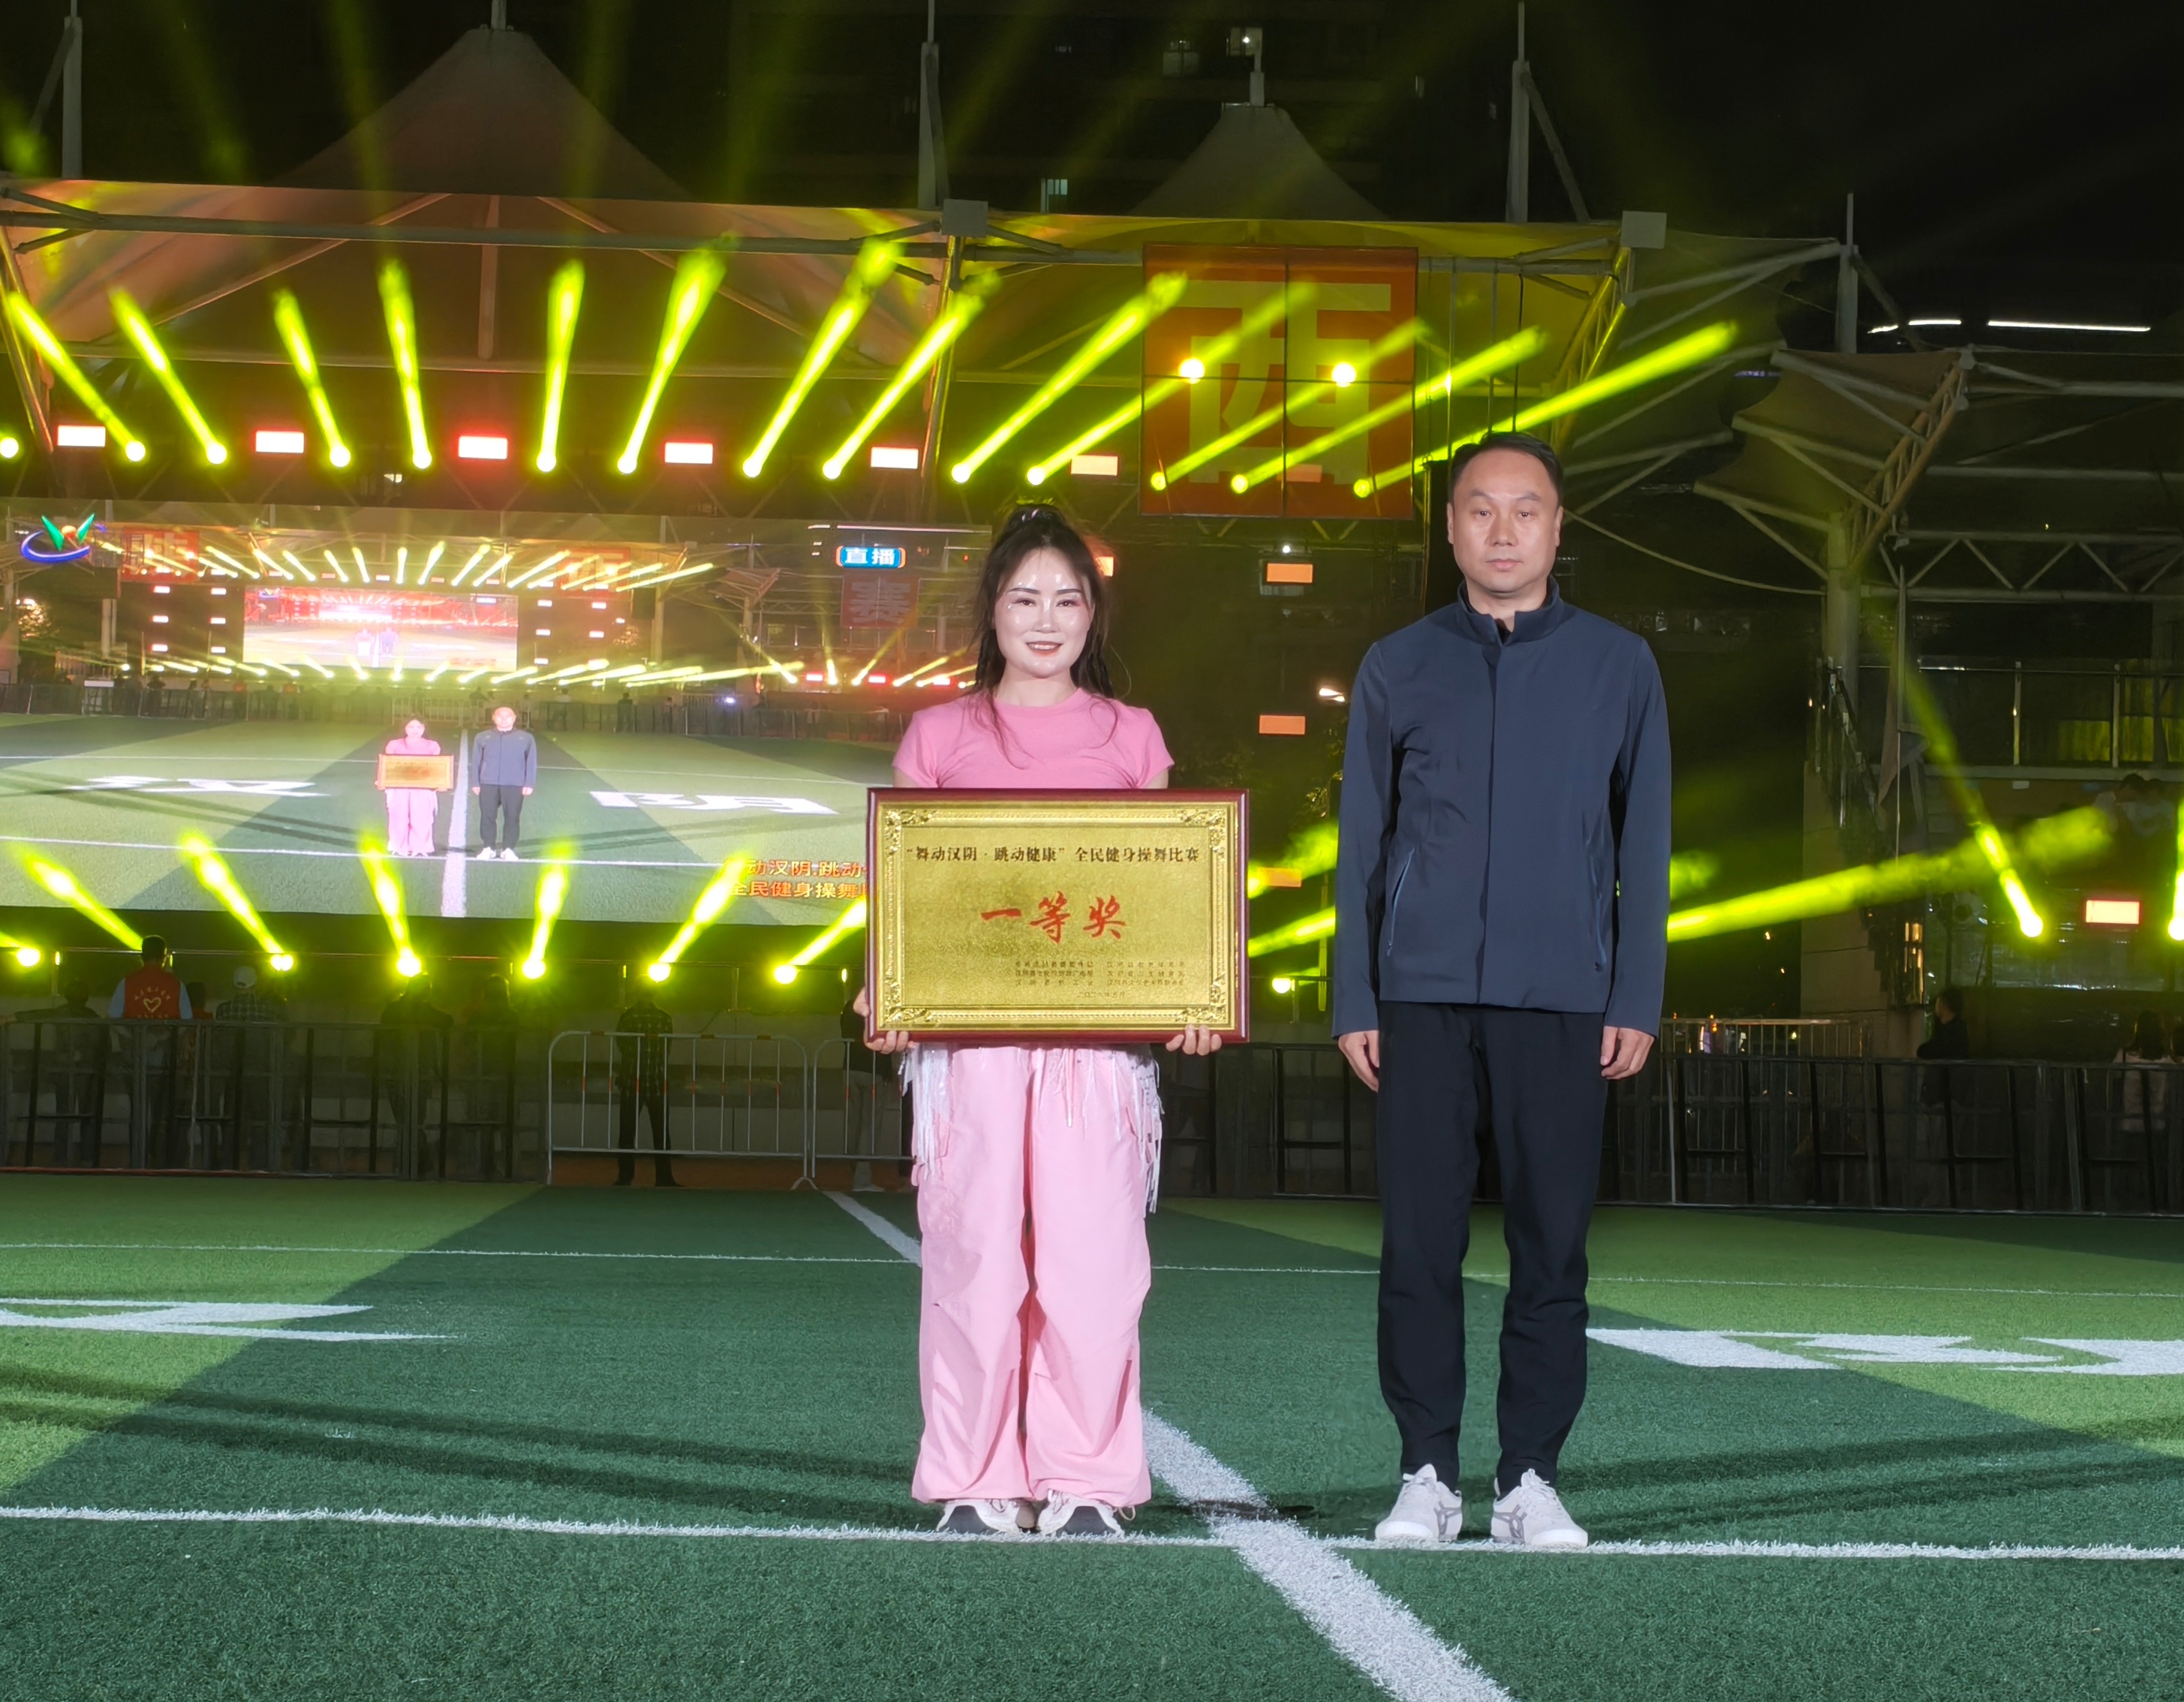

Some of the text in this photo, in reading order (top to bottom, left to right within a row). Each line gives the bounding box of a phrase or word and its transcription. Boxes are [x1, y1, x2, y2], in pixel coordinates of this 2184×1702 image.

[1172, 279, 1391, 484] 西
[844, 548, 895, 565] 直播
[981, 891, 1126, 944] 一等奖
